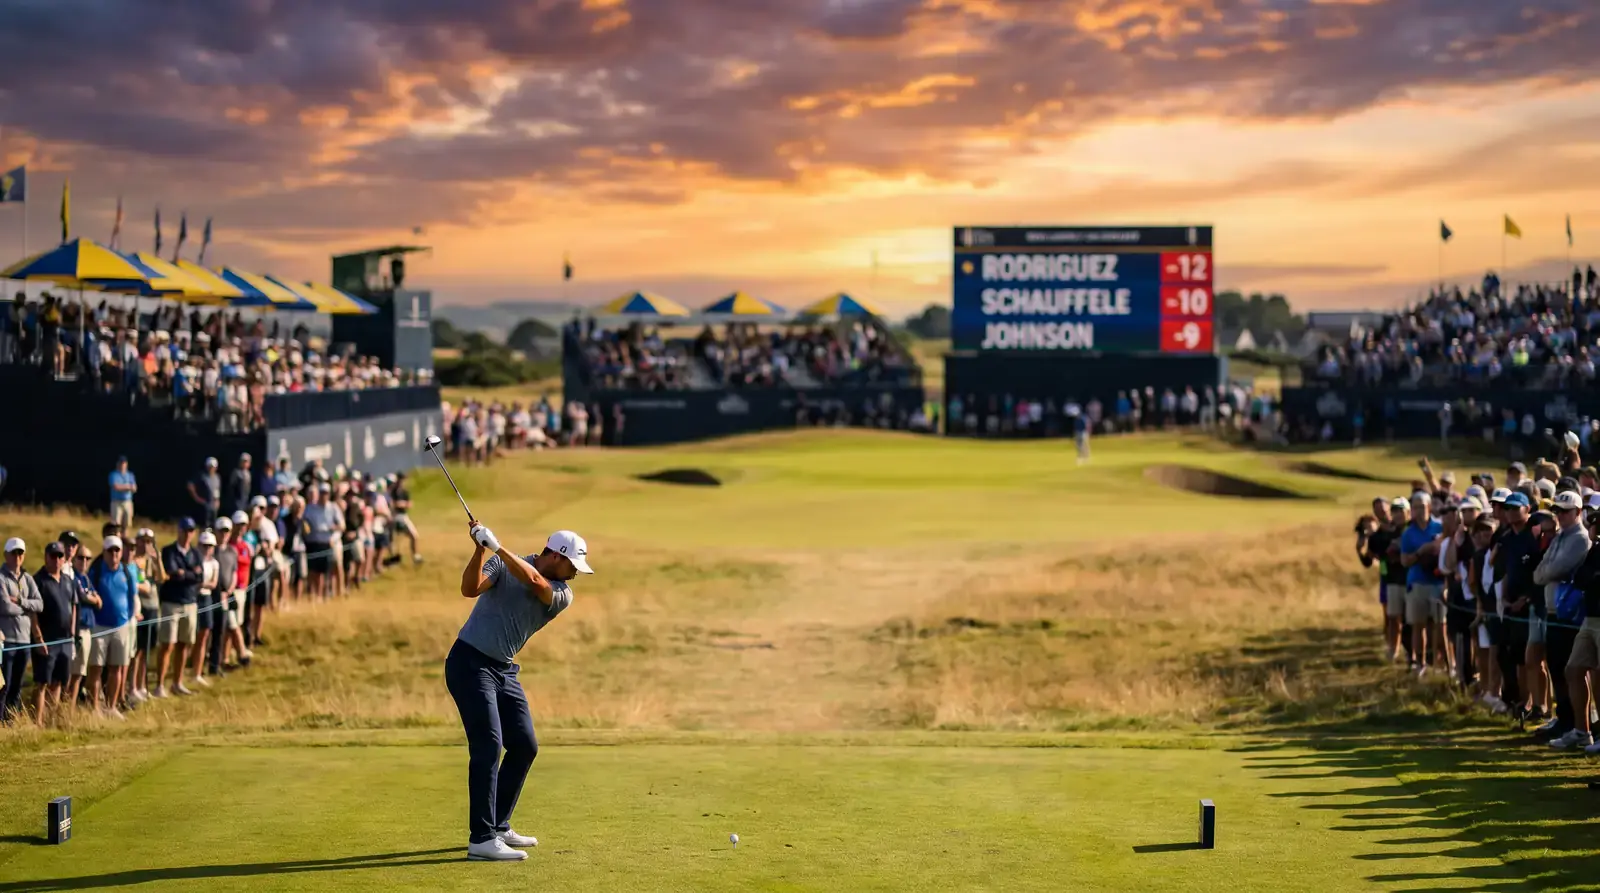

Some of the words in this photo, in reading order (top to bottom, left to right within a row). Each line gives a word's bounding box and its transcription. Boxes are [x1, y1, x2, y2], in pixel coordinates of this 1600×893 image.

[981, 254, 1118, 281] RODRIGUEZ
[1166, 255, 1208, 281] -12
[981, 288, 1131, 315] SCHAUFFELE
[1166, 289, 1208, 315] -10
[981, 322, 1094, 349] JOHNSON
[1174, 322, 1200, 349] -9
